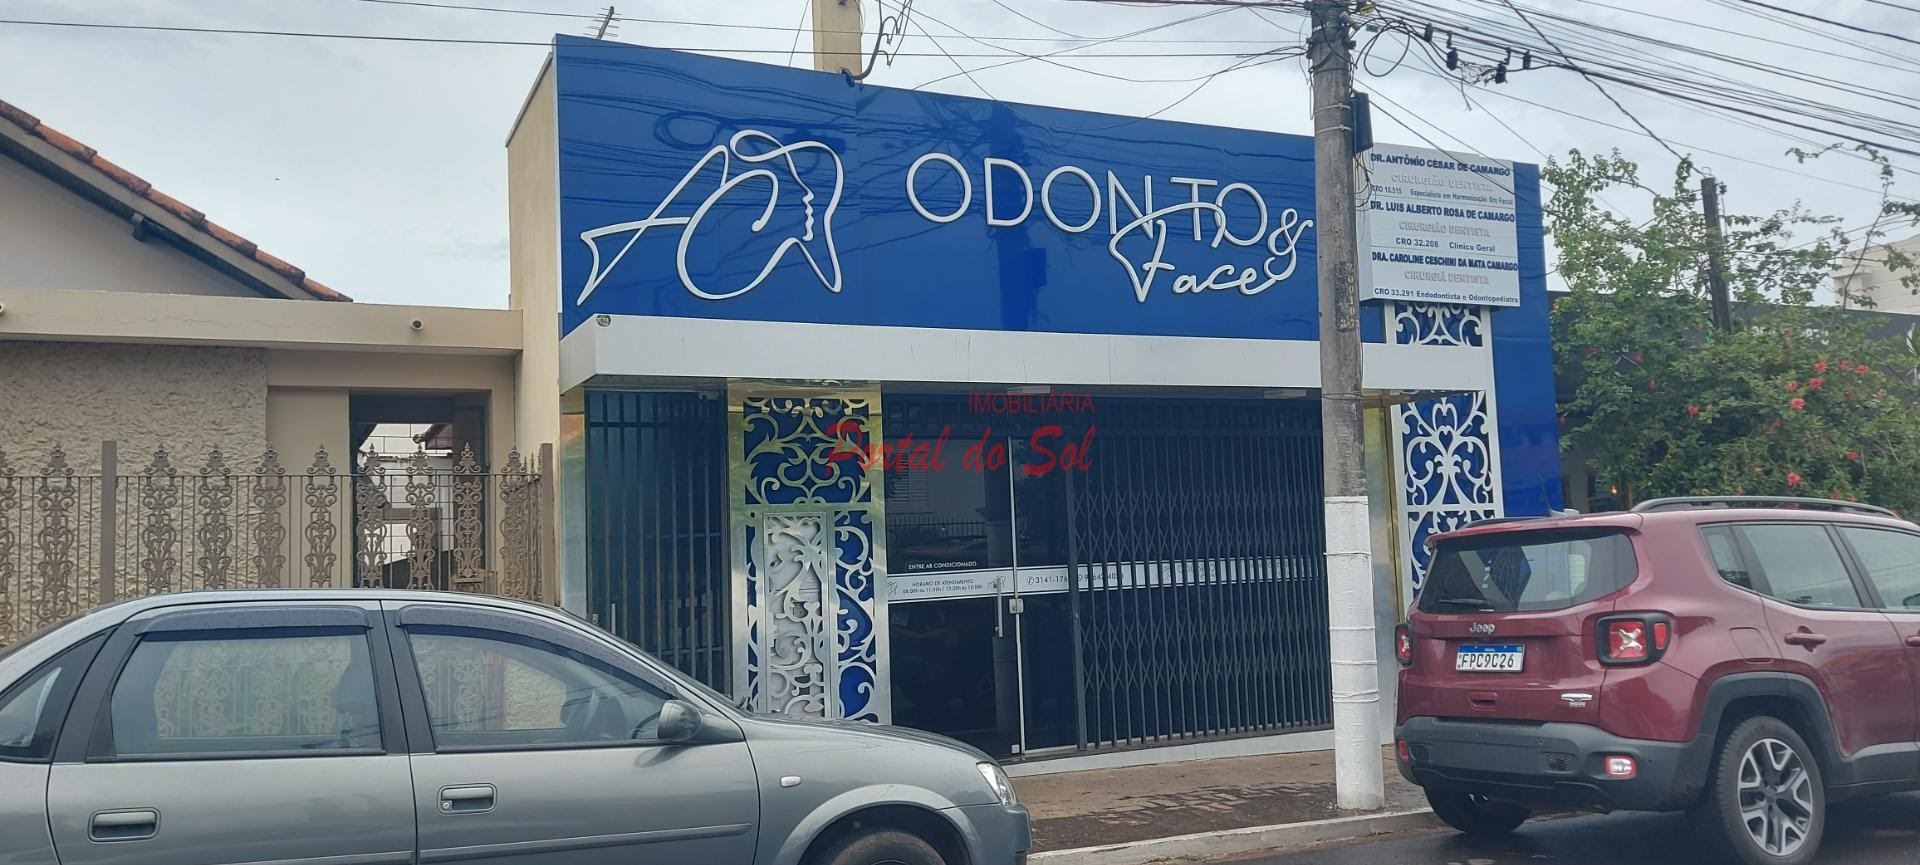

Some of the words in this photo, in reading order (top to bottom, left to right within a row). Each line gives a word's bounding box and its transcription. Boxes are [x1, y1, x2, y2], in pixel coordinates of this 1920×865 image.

[1385, 153, 1426, 167] ANTÔNIO
[1457, 162, 1469, 172] DE
[1469, 164, 1511, 177] CAMARGO
[1391, 172, 1446, 187] CIRURGIÃO
[1448, 179, 1493, 192] DENTISTA
[905, 152, 1267, 247] ODONTO
[1410, 188, 1442, 200] Especialista
[1452, 192, 1487, 204] Harmonização
[1370, 200, 1384, 210] DR.
[1385, 202, 1405, 213] LUIS
[1405, 203, 1442, 216] ALBERTO
[1443, 207, 1465, 218] ROSA
[1466, 209, 1477, 219] DE
[1477, 211, 1515, 223] CAMARGO
[1398, 220, 1447, 234] CIRURGIÃO
[1448, 225, 1490, 238] DENTISTA
[1109, 201, 1276, 303] Face
[1395, 237, 1412, 246] CRO
[1413, 238, 1439, 248] 32.208
[1476, 244, 1496, 252] Geral
[1372, 251, 1389, 262] DRA.
[1389, 253, 1424, 265] CAROLINE
[1425, 255, 1457, 267] CESCHINI
[1458, 258, 1468, 267] DA
[1468, 259, 1486, 269] MATA
[1486, 260, 1518, 271] CAMARGO
[1448, 274, 1490, 285] DENTISTA
[1374, 287, 1389, 295] CRO
[1416, 290, 1461, 301] Endodontista
[1468, 293, 1518, 304] Odontopediatra
[933, 560, 977, 569] CONDICIONADO
[1469, 622, 1496, 635] Jeep
[1461, 653, 1514, 668] FPC9C26
